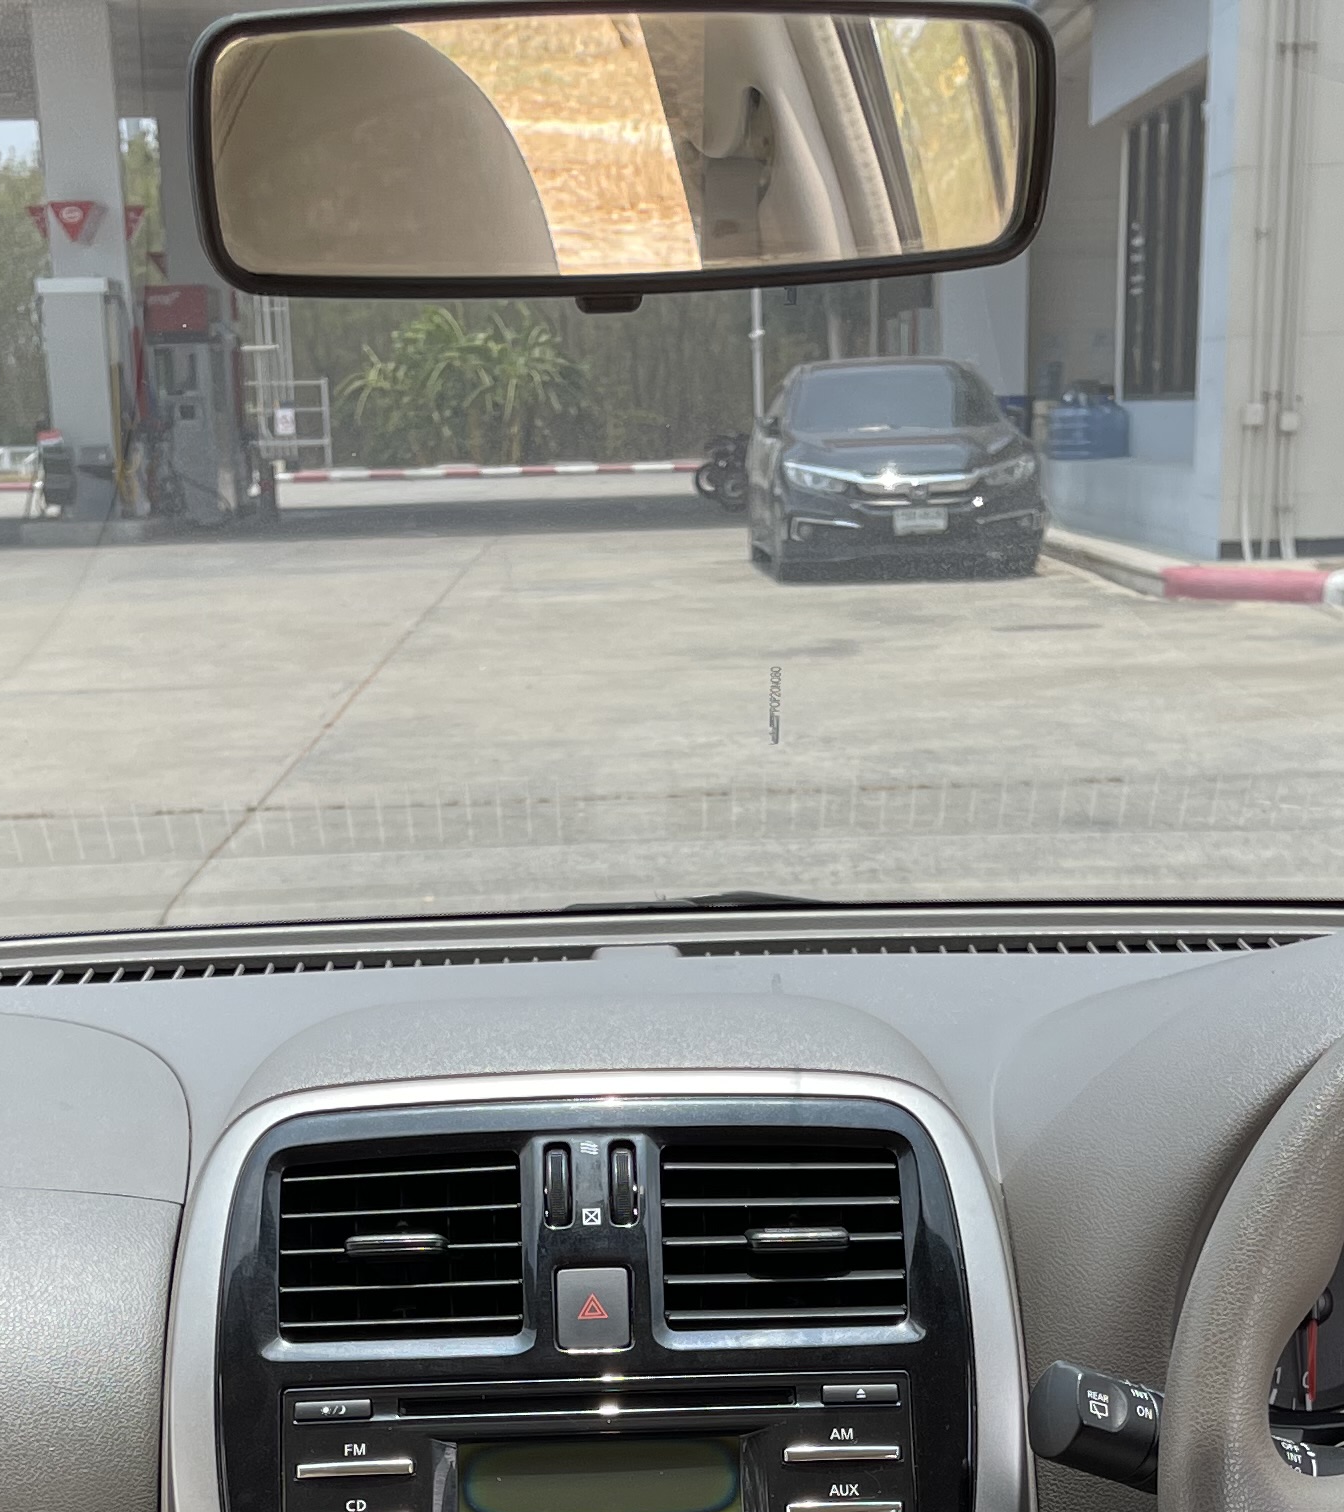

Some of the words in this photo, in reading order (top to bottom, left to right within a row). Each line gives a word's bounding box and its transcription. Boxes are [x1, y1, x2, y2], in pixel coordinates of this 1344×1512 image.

[1087, 1389, 1110, 1403] REAR
[1136, 1405, 1154, 1420] ON
[828, 1427, 855, 1442] AM
[343, 1443, 367, 1458] FM
[829, 1482, 861, 1498] AUX
